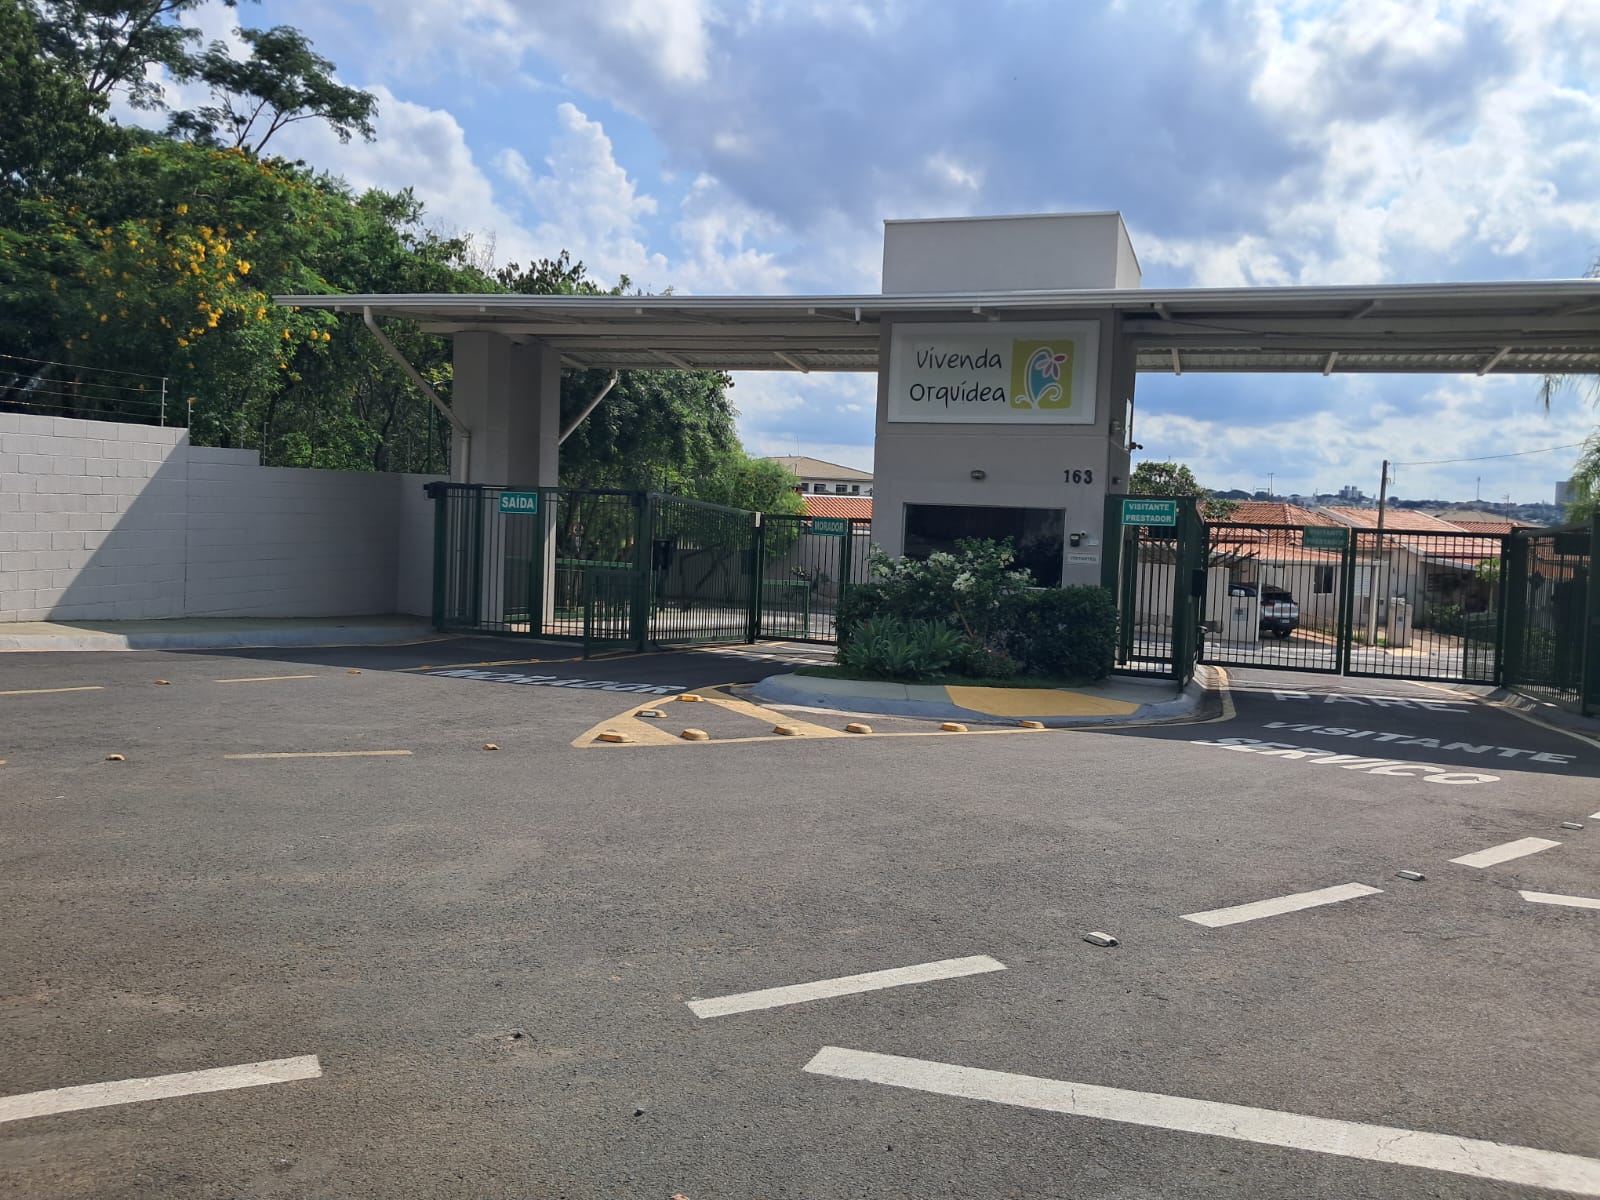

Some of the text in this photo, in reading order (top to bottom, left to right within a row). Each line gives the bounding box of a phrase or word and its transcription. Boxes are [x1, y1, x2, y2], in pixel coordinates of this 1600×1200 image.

[909, 380, 1006, 408] Orquídea
[1063, 469, 1093, 484] 163
[502, 495, 534, 509] SAÍDA
[1129, 503, 1170, 511] VISITANTE
[1126, 514, 1172, 522] PRESTADOR
[814, 521, 844, 532] MORADOR
[424, 669, 688, 694] MORADOR
[1272, 690, 1471, 713] PARE
[1261, 721, 1577, 765] VISITANTE
